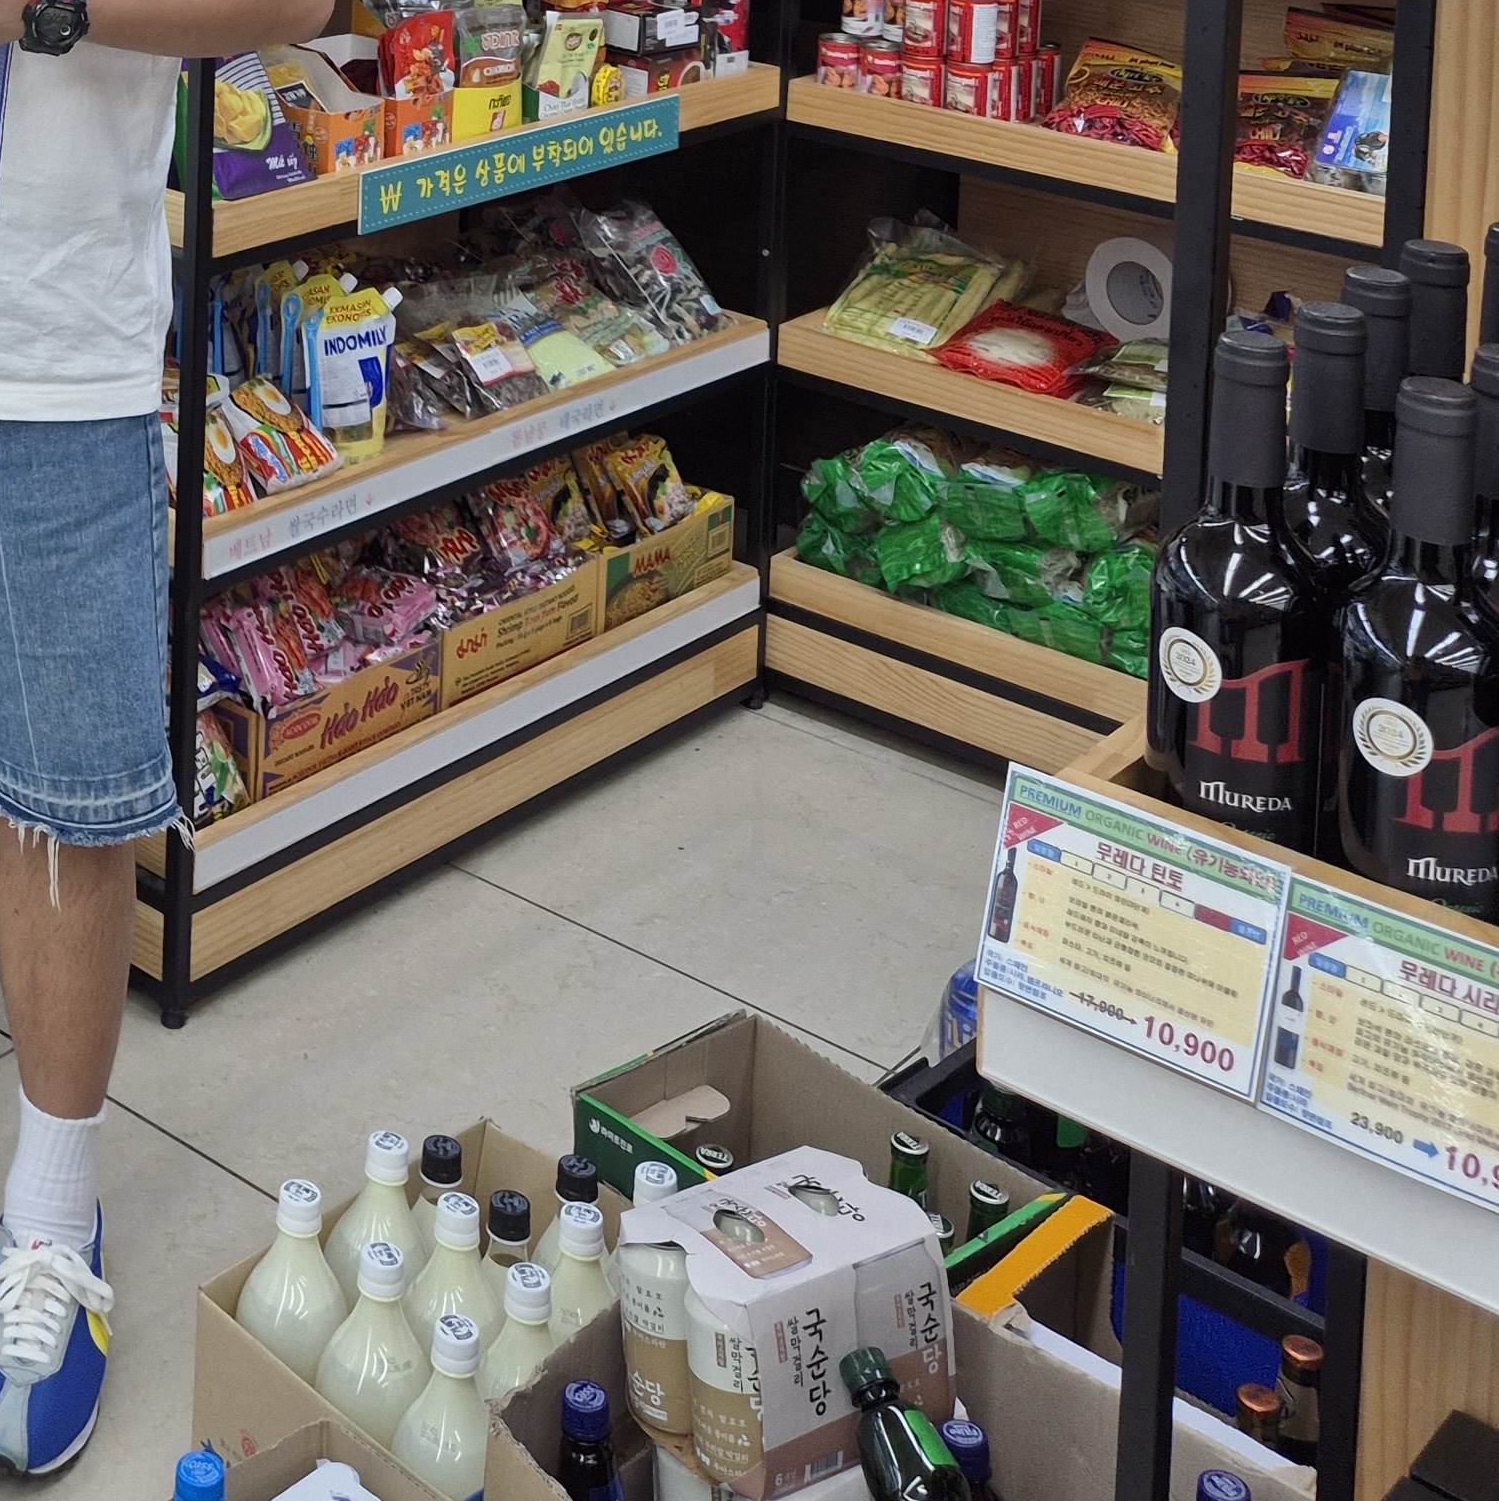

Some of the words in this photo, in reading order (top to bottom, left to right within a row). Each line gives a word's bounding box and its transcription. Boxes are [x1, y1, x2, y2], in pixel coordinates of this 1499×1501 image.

[416, 169, 467, 200] 가격은
[475, 156, 526, 188] 상품에
[532, 138, 594, 174] 부착되어
[599, 122, 663, 159] 있습니다.
[632, 546, 671, 578] MAMA
[1019, 784, 1082, 818] PREMIUM
[1084, 809, 1144, 841] ORGANIC
[1146, 831, 1183, 856] WINE
[1199, 780, 1292, 813] MUREDA
[1096, 841, 1146, 876] 무레다
[1150, 862, 1184, 892] 틴토
[1407, 856, 1499, 887] MUREDA
[1372, 921, 1441, 956] ORGANIC
[1444, 946, 1485, 972] WINE
[1399, 960, 1457, 995] 무레다
[1078, 991, 1124, 1020] 17,900
[1144, 1015, 1235, 1072] 10,900
[700, 1146, 729, 1162] TERRA
[1350, 1112, 1404, 1144] 23,900
[904, 1289, 919, 1349] 쌀막걸리
[917, 1281, 945, 1375] 국순당
[728, 1336, 744, 1392] 쌀막걸리
[786, 1316, 804, 1387] 쌀막걸리
[802, 1307, 833, 1417] 국순당
